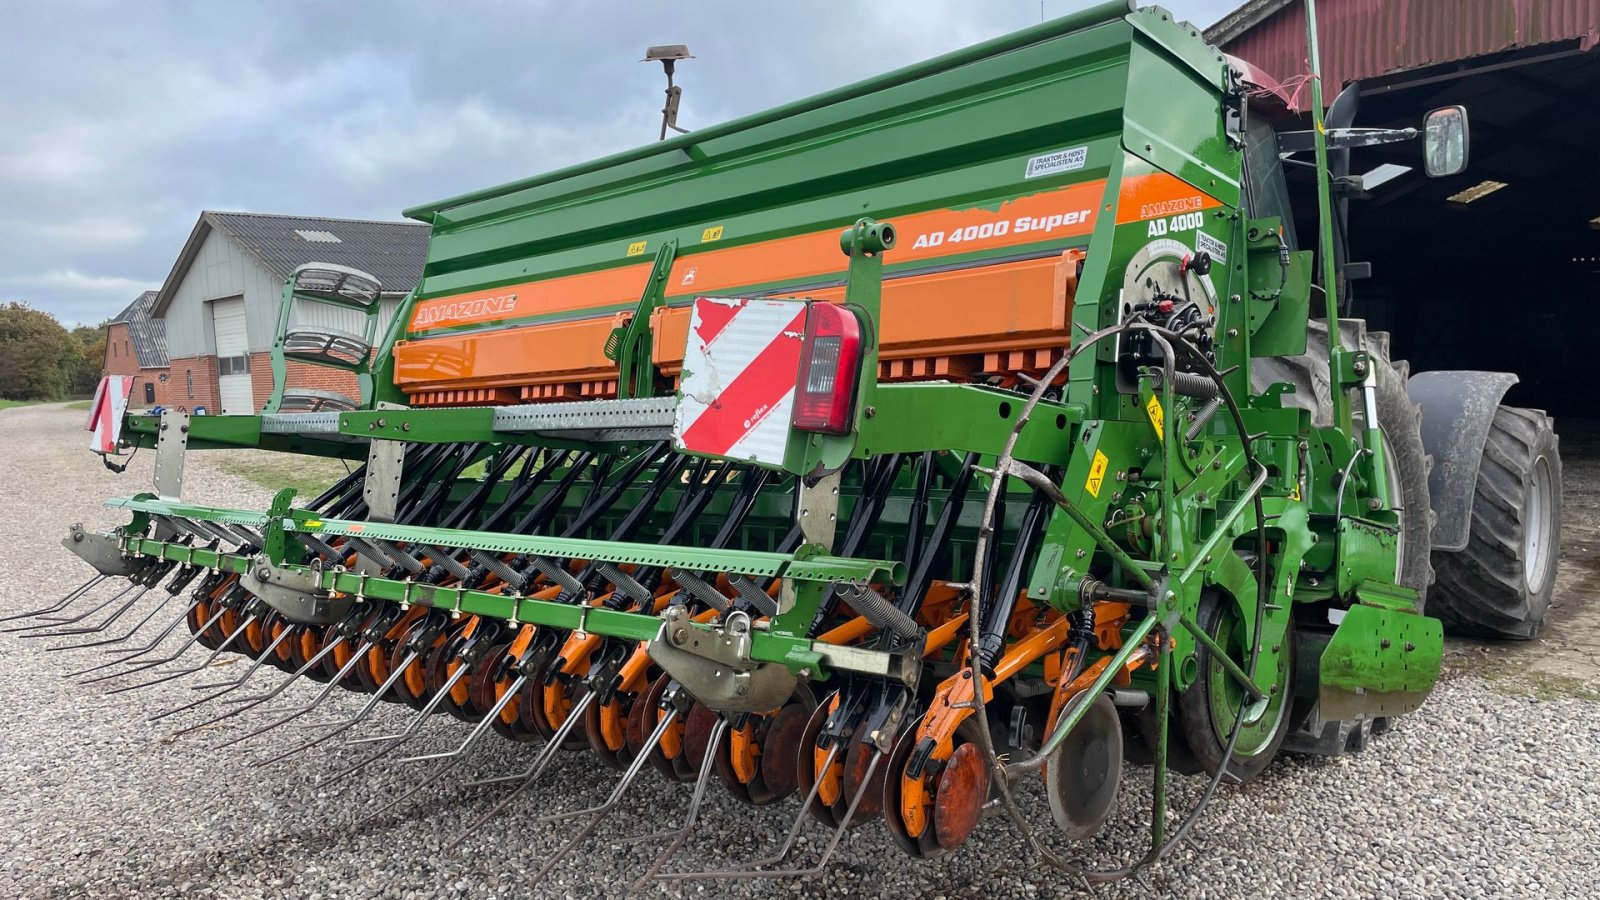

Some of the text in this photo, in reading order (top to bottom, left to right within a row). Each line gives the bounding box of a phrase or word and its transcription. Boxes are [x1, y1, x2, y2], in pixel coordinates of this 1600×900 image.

[1035, 158, 1073, 170] SPECIALISTEN
[1036, 154, 1063, 164] TRAKTOR
[1140, 196, 1202, 218] AMAZONE
[912, 209, 1091, 249] AD 4000 Super
[1147, 211, 1204, 238] AD 4000
[412, 294, 517, 325] AMAZONE
[750, 404, 769, 423] reflex
